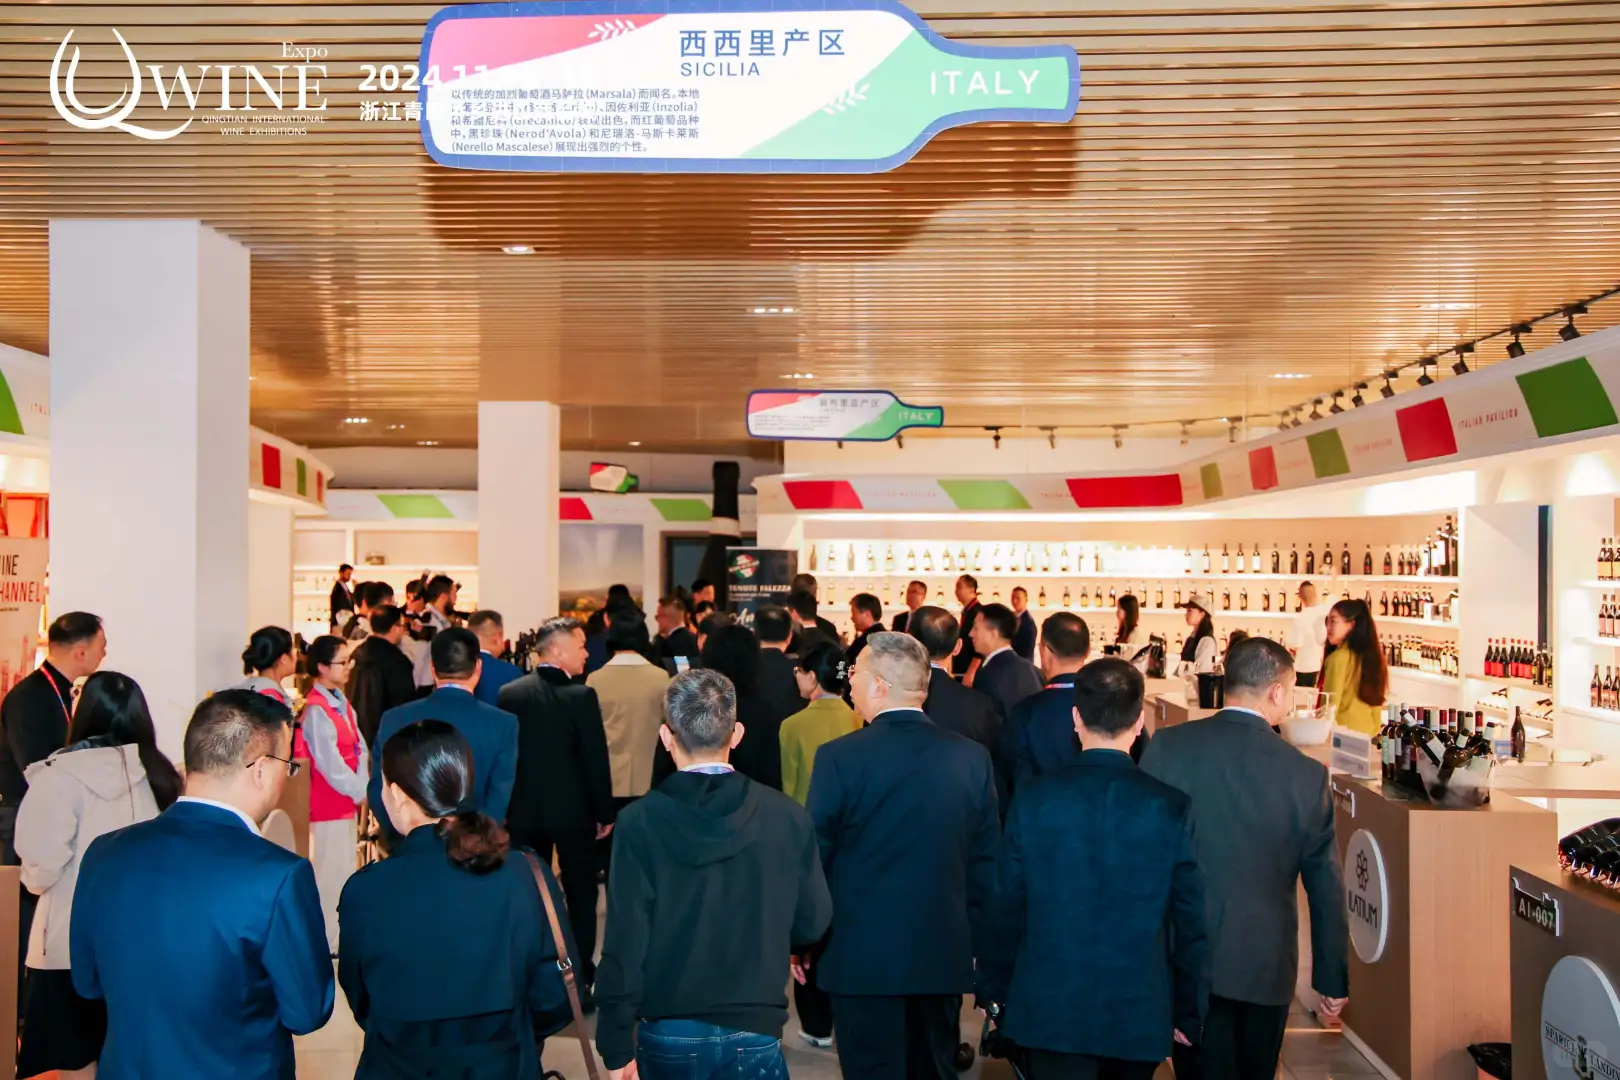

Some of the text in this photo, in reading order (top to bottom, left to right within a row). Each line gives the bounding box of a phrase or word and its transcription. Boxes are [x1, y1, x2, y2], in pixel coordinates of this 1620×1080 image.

[679, 28, 845, 58] 西西里产区
[680, 61, 761, 77] SICILIA
[929, 69, 1041, 96] ITALY
[898, 411, 934, 423] ITALY
[0, 555, 19, 576] INE
